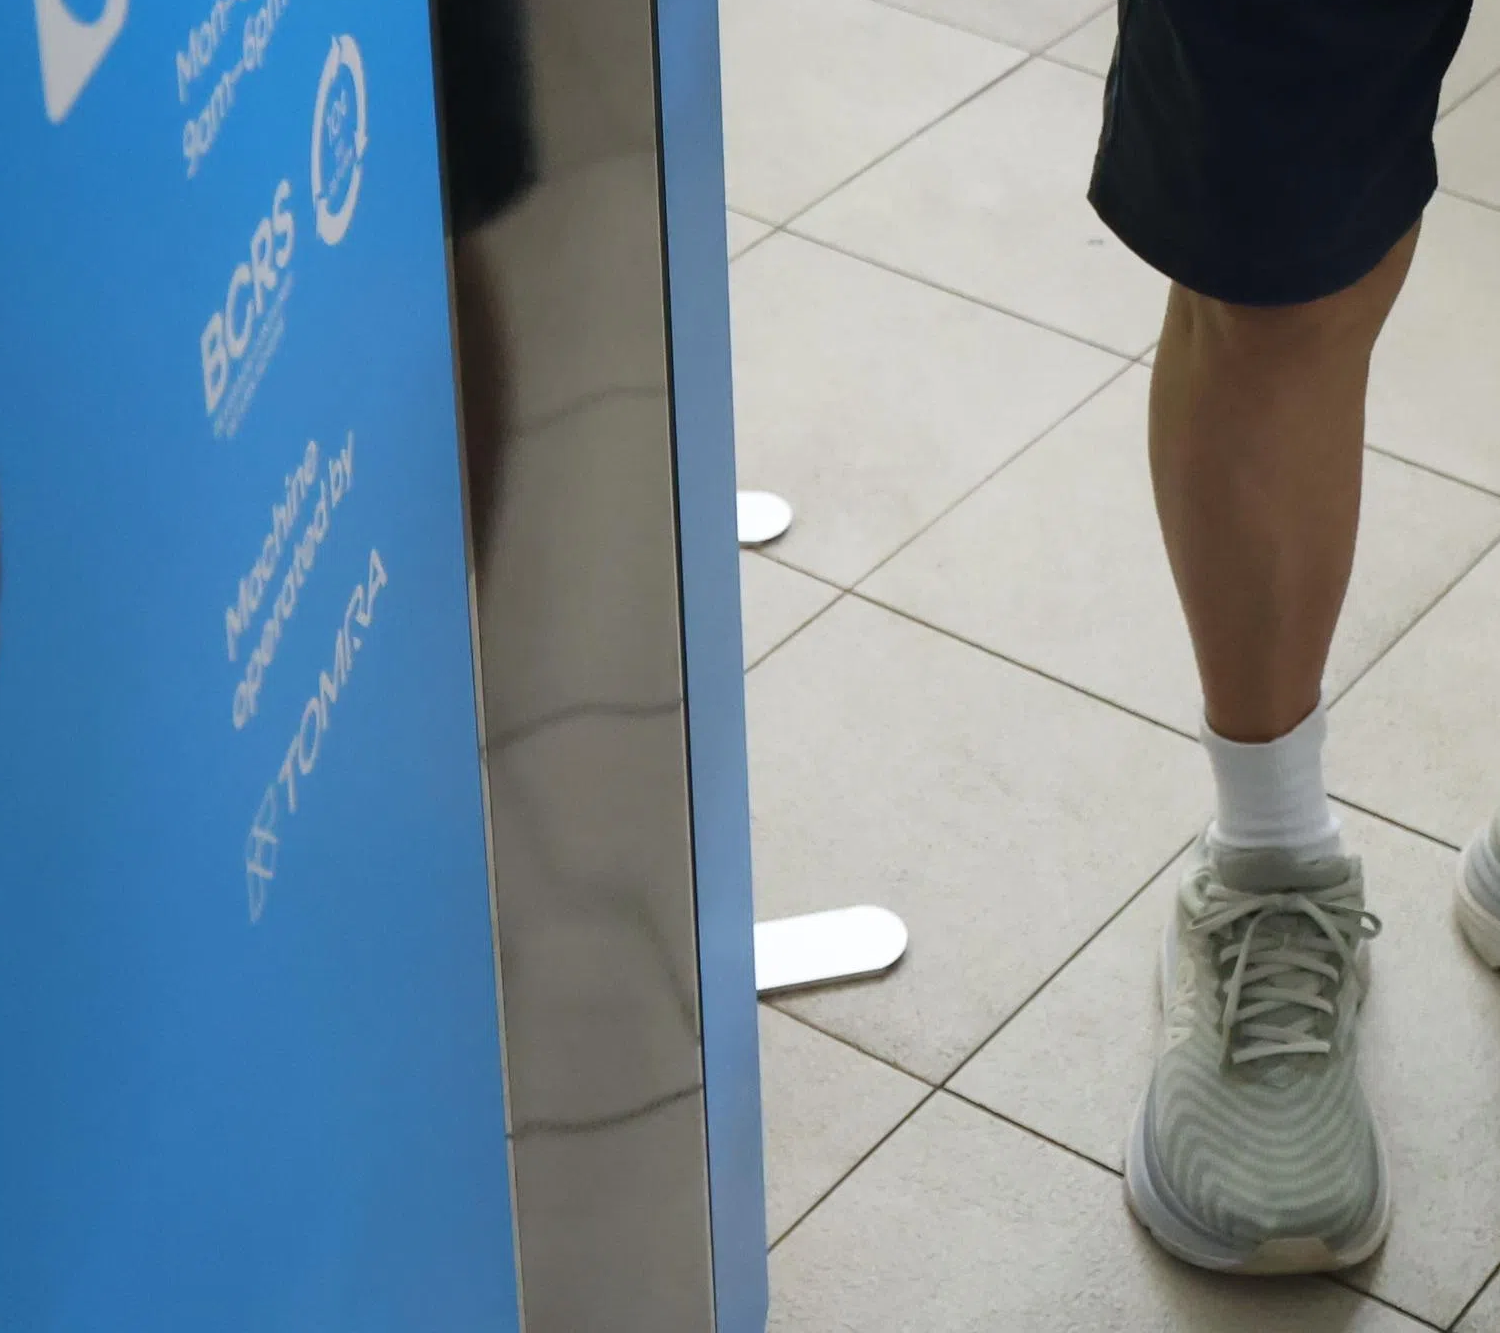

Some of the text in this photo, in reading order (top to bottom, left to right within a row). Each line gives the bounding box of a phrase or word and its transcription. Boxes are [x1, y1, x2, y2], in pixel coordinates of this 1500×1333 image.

[200, 178, 295, 418] BCRS
[226, 439, 320, 662] Machine
[233, 476, 331, 730] operated
[328, 429, 355, 509] by
[278, 548, 388, 815] TOMRA
